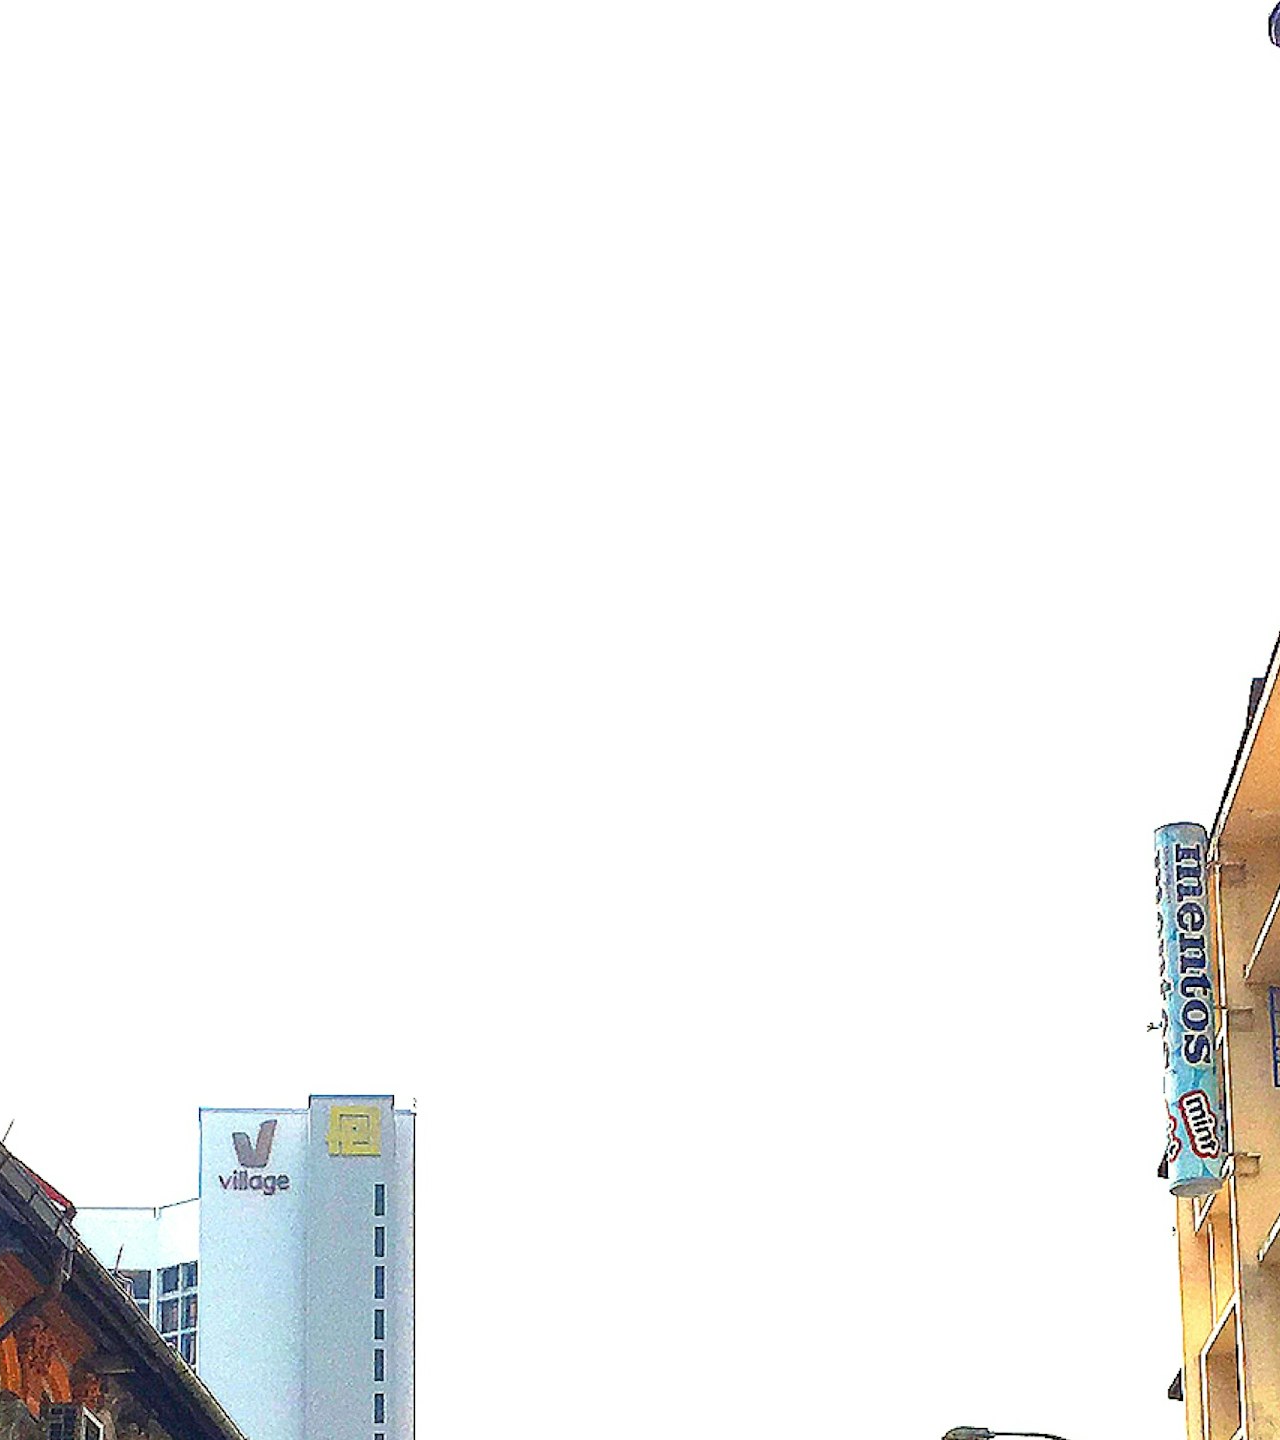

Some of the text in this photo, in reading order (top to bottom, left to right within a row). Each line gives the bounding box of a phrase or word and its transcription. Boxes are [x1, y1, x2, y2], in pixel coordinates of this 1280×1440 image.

[1176, 842, 1212, 1065] mentos
[1184, 1092, 1218, 1157] mint
[219, 1169, 291, 1196] village
